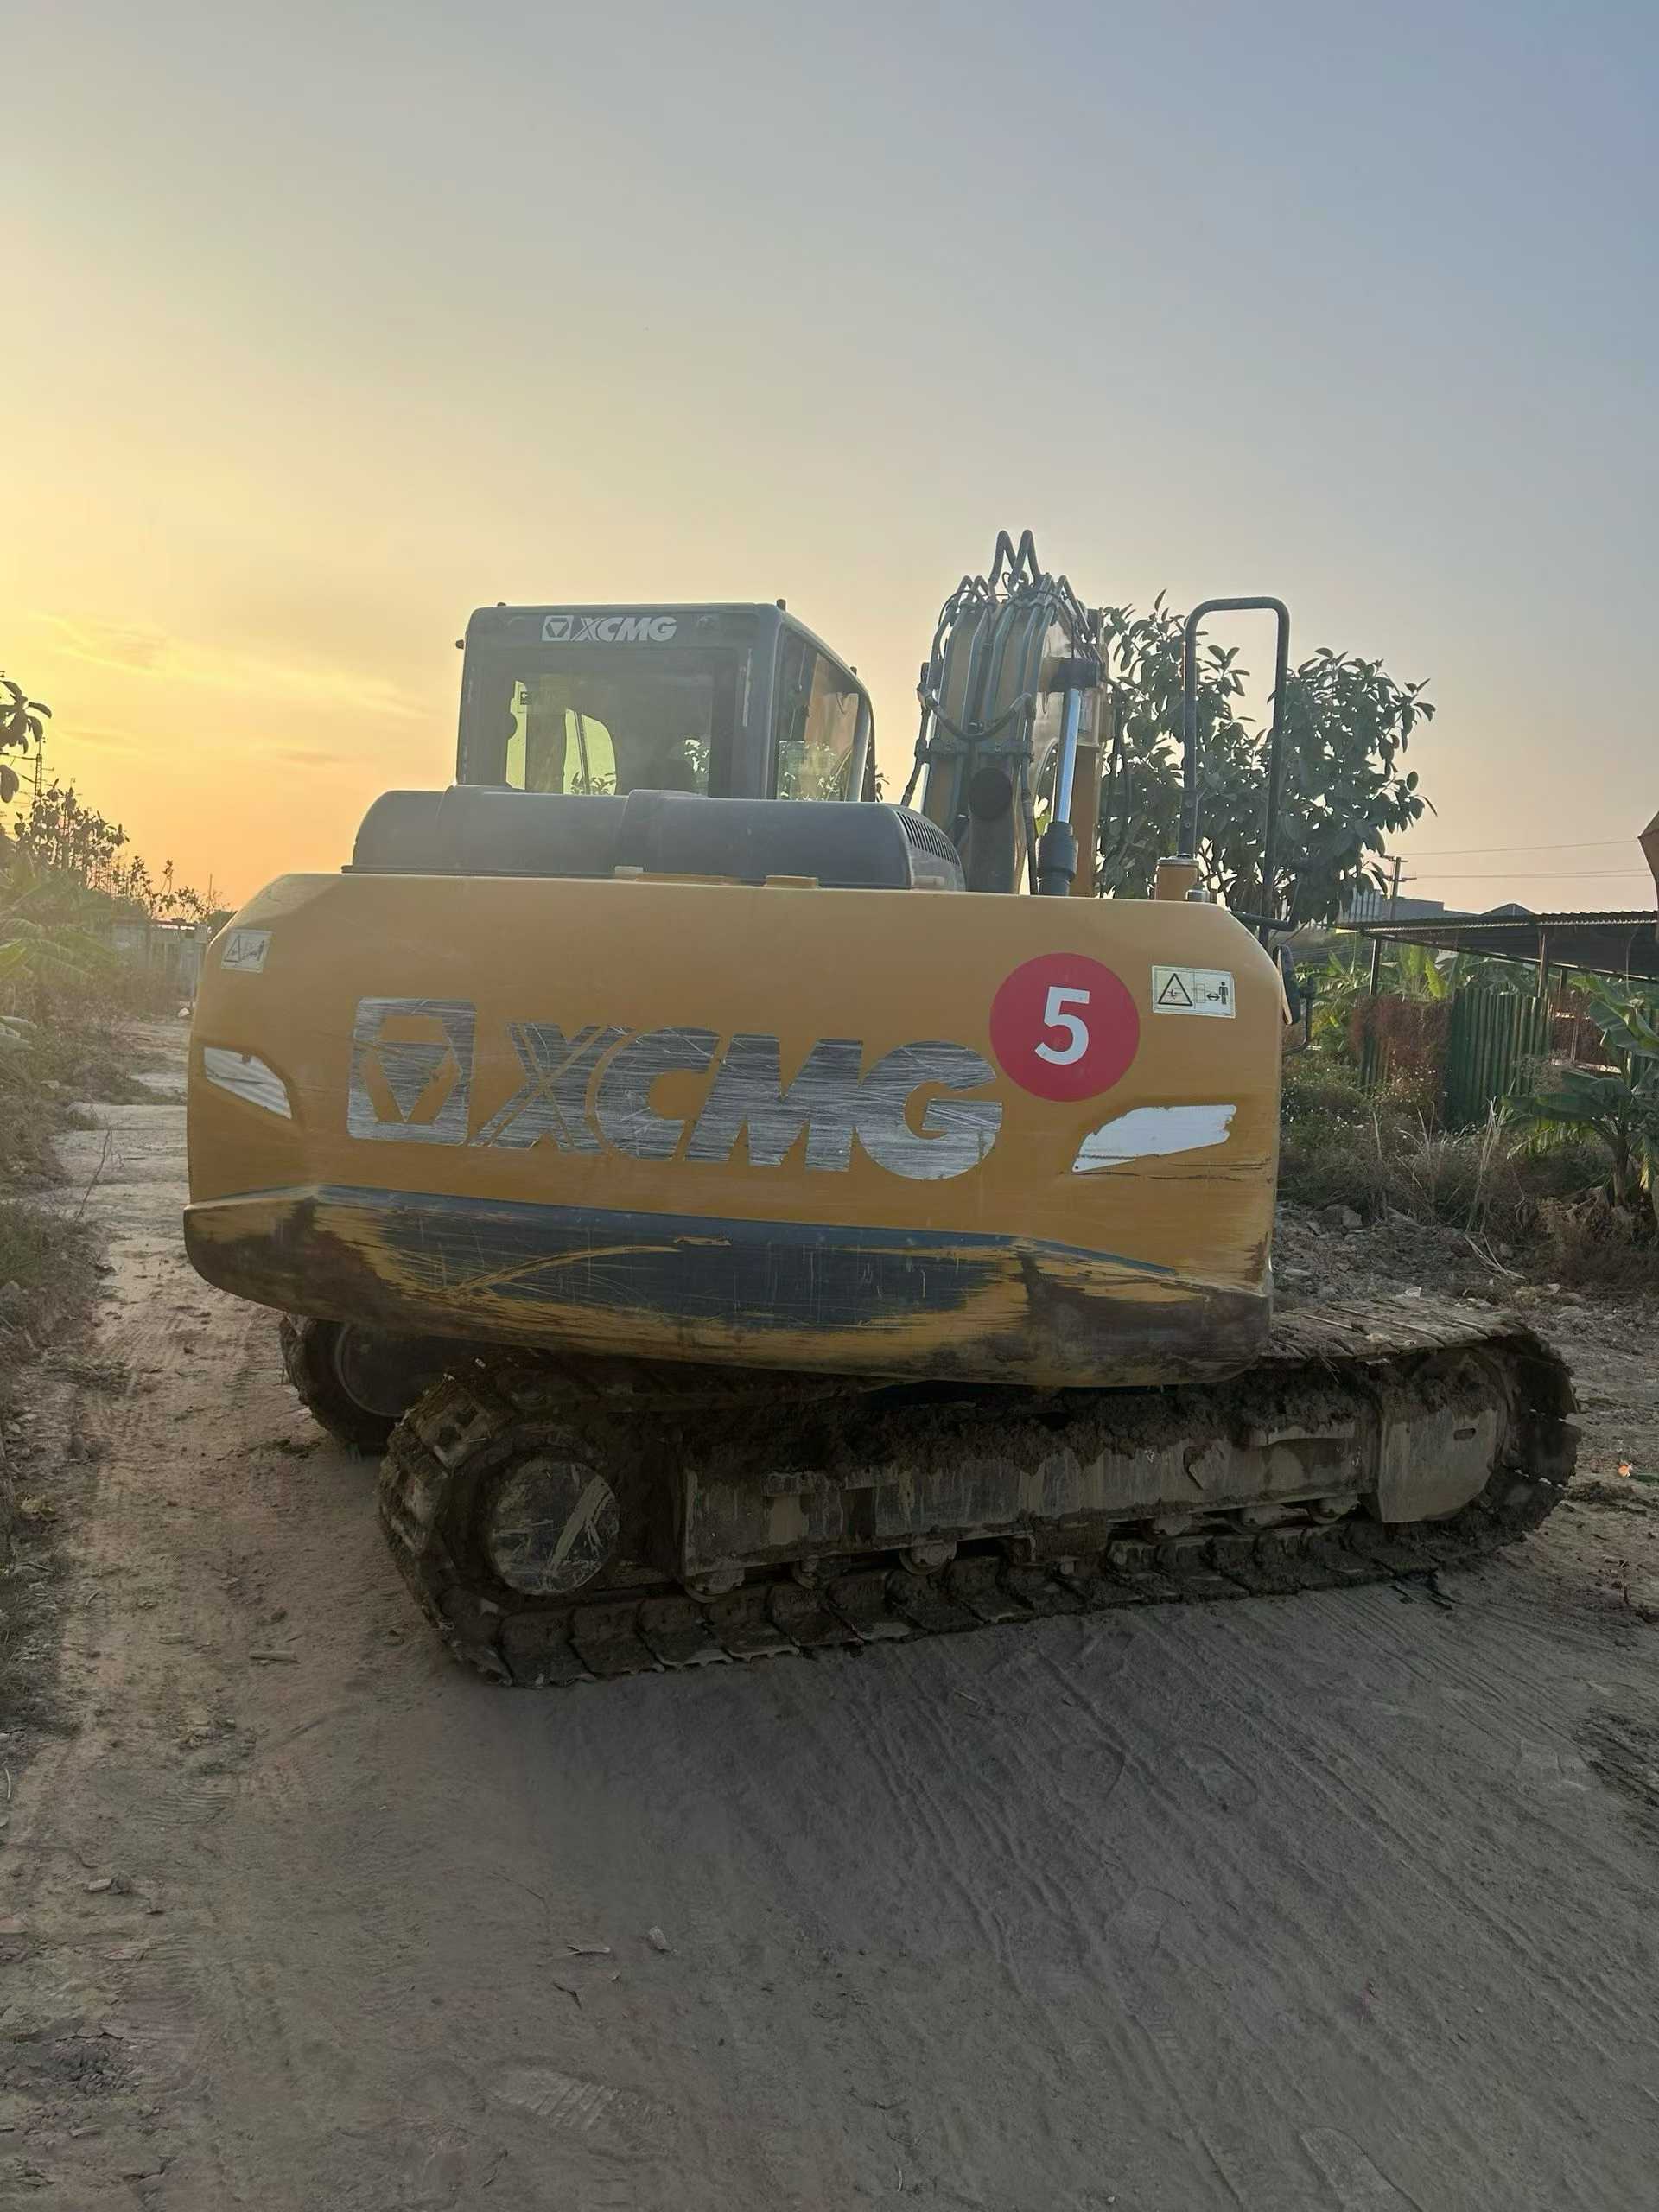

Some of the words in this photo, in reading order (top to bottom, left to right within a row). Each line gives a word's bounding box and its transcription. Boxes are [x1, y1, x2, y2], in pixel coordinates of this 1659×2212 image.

[570, 616, 677, 642] XCMG
[1034, 986, 1090, 1065] 5
[467, 1022, 1003, 1181] XCMG
